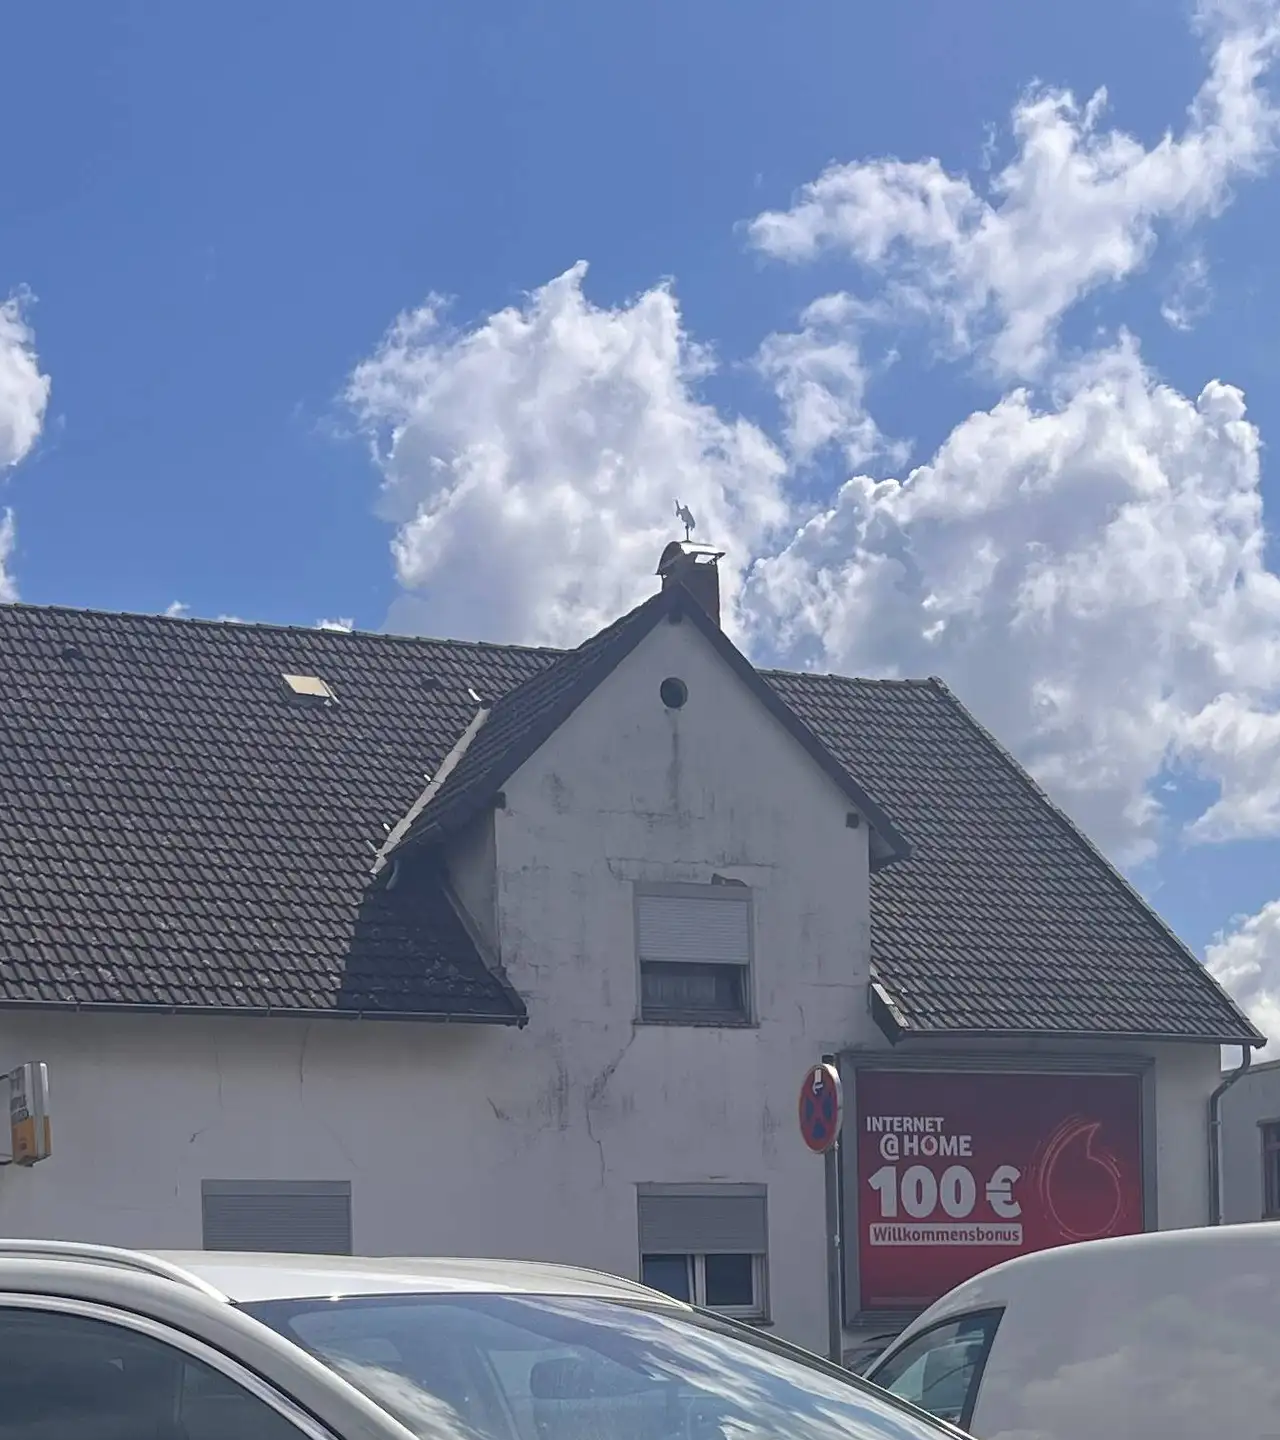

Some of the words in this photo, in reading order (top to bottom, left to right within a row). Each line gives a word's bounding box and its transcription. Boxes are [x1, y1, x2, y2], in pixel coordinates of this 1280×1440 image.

[866, 1116, 945, 1133] INTERNET
[879, 1133, 973, 1161] @HOME
[867, 1164, 977, 1219] 100
[985, 1164, 1022, 1219] €
[873, 1226, 1020, 1242] Willkommensbonus
